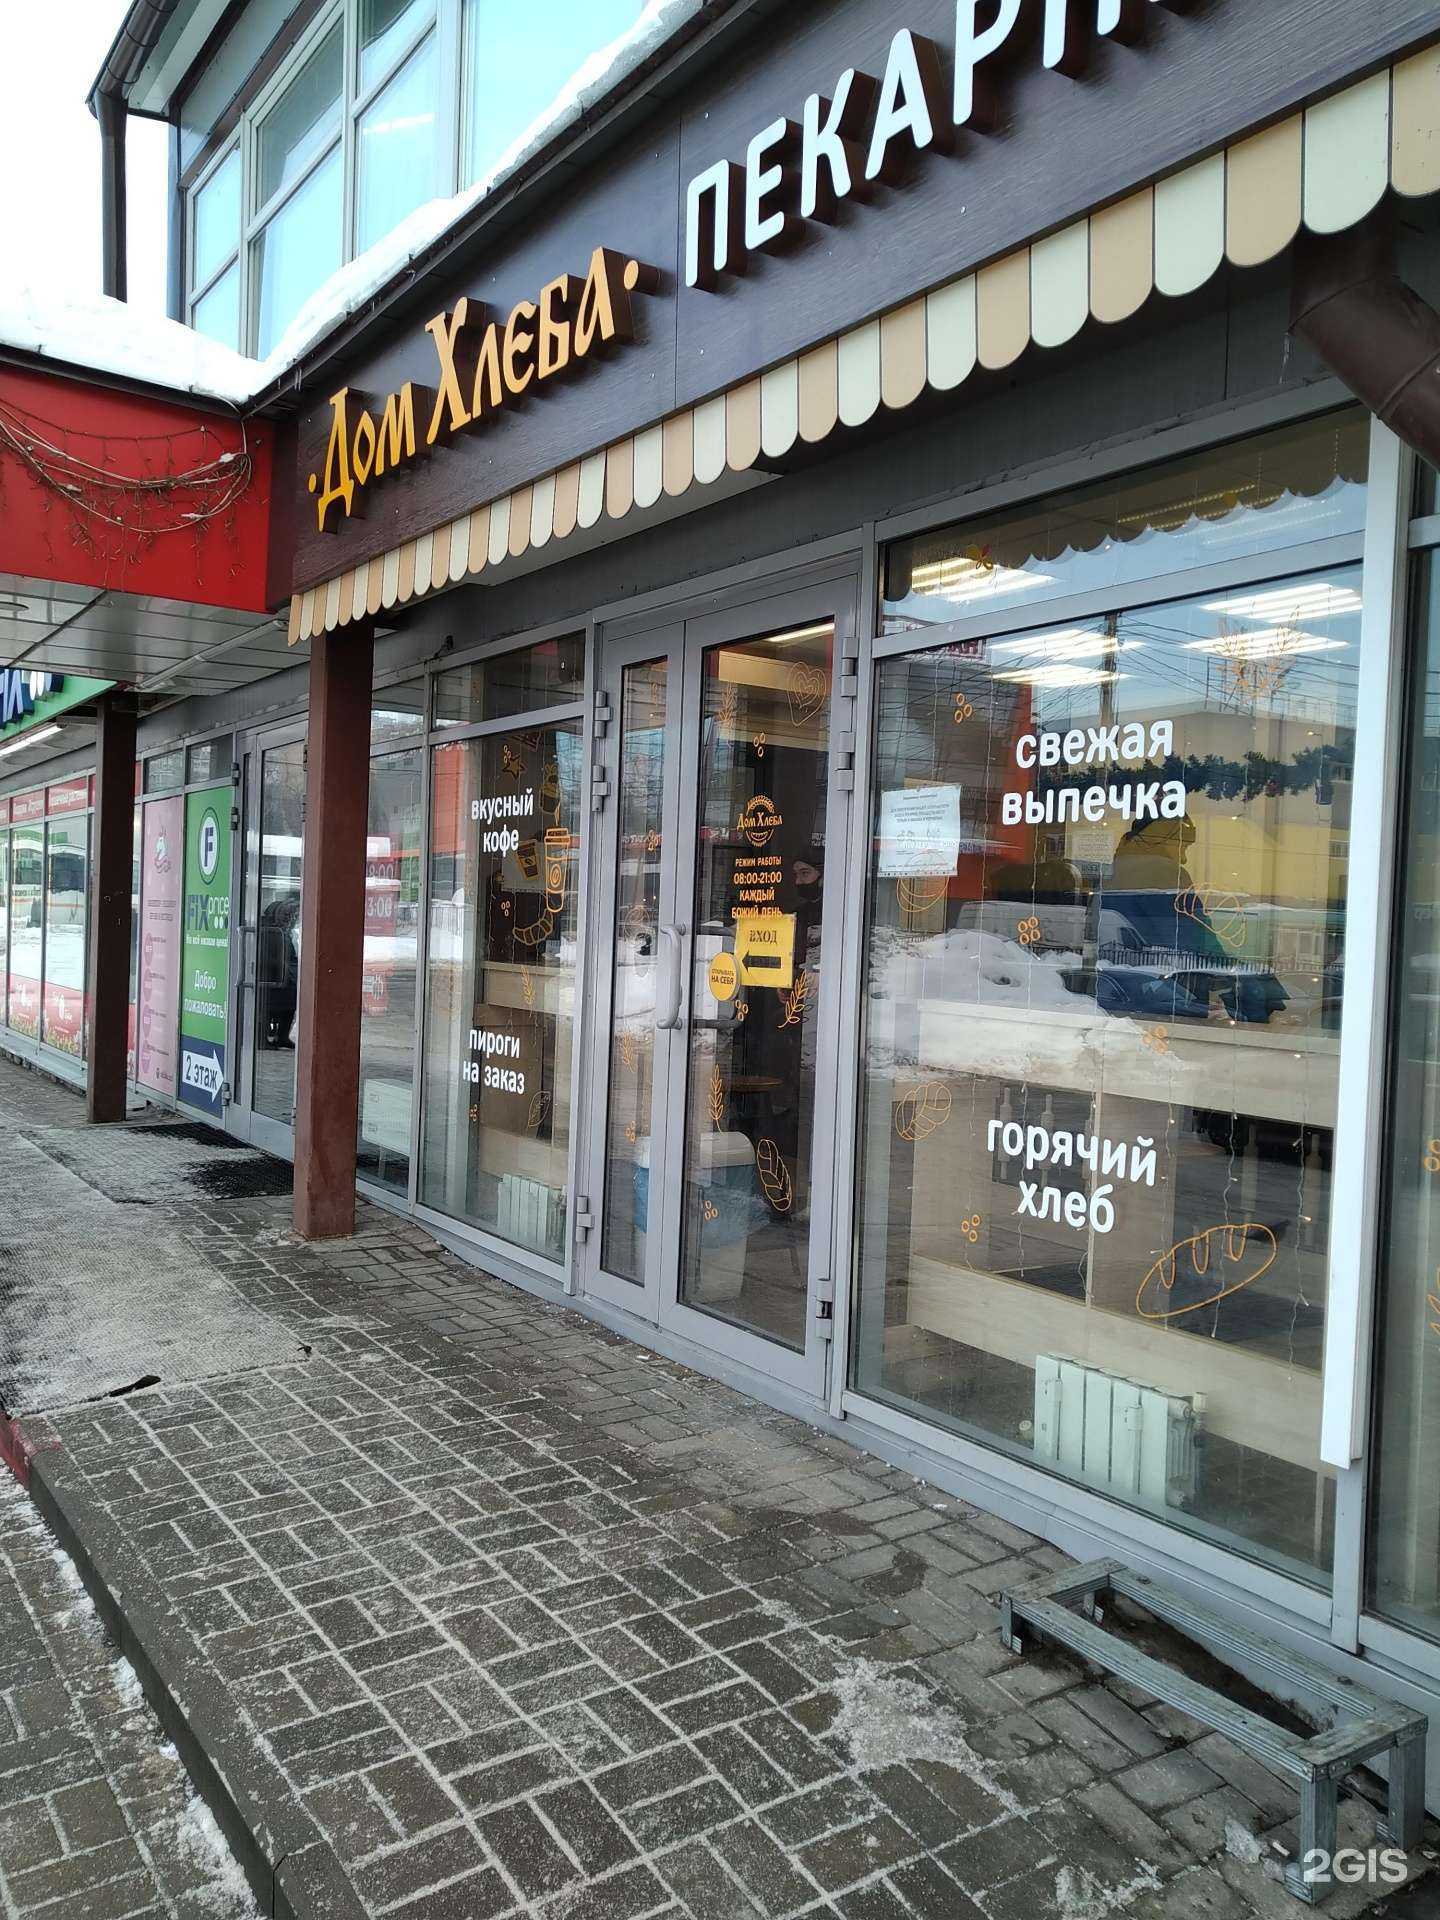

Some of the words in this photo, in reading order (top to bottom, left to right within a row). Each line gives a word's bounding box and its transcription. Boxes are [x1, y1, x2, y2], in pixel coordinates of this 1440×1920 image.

[1016, 719, 1173, 769] свежая
[471, 787, 534, 825] вкусный
[1002, 780, 1186, 826] выпечка
[483, 823, 519, 858] кофе
[735, 858, 756, 867] РЕЖИМ
[757, 855, 782, 866] РАБОТЫ
[733, 871, 783, 885] 08:00-21:00
[739, 886, 775, 903] КАЖДЫЙ
[731, 904, 759, 919] БОЖИЙ
[760, 906, 783, 919] ДЕНЬ
[749, 930, 778, 947] ВХОД
[194, 969, 217, 993] Добро
[711, 974, 720, 984] НА
[720, 975, 734, 985] СЕБЯ
[469, 1029, 520, 1059] пироги
[186, 1054, 191, 1081] 2
[194, 1063, 218, 1091] этаж
[462, 1060, 480, 1083] на
[484, 1065, 525, 1095] заказ
[987, 1119, 1157, 1186] горячий
[1018, 1180, 1115, 1233] хлеб
